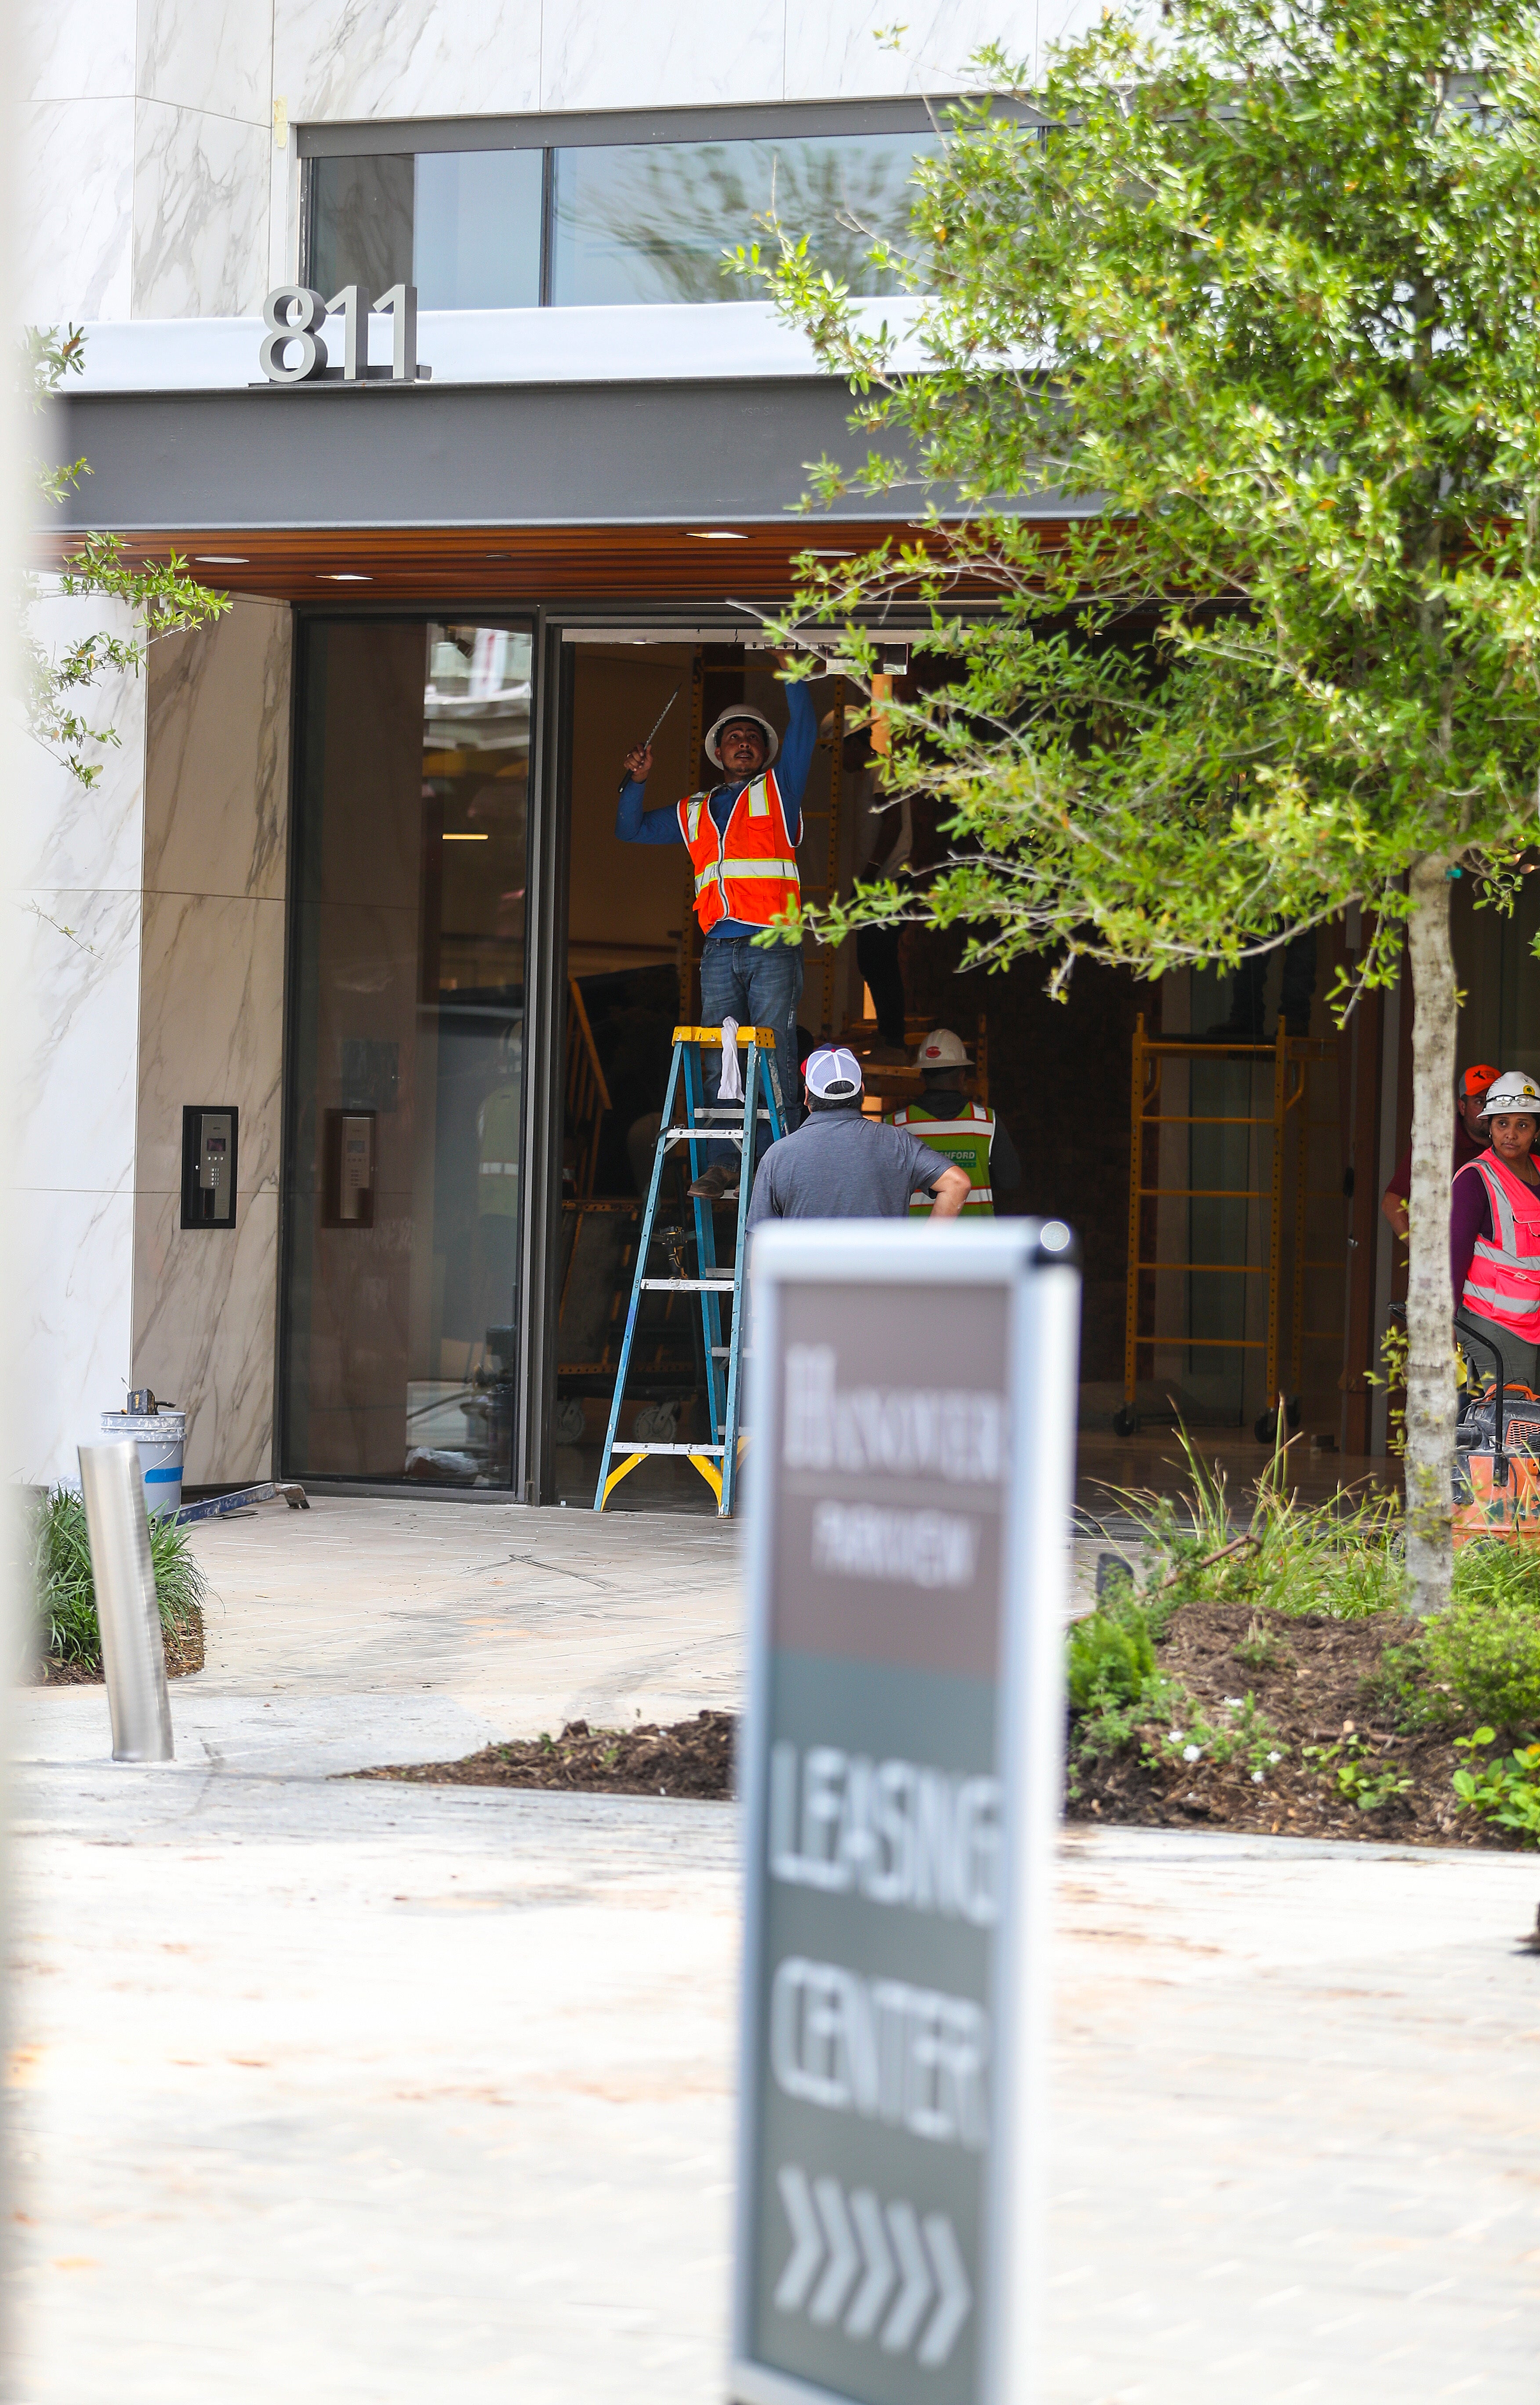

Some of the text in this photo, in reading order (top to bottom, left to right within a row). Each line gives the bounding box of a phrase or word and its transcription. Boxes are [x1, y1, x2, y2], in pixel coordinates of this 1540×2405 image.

[259, 284, 407, 382] 811
[771, 1740, 1004, 1926] LEASING
[770, 1957, 987, 2150] CENTER
